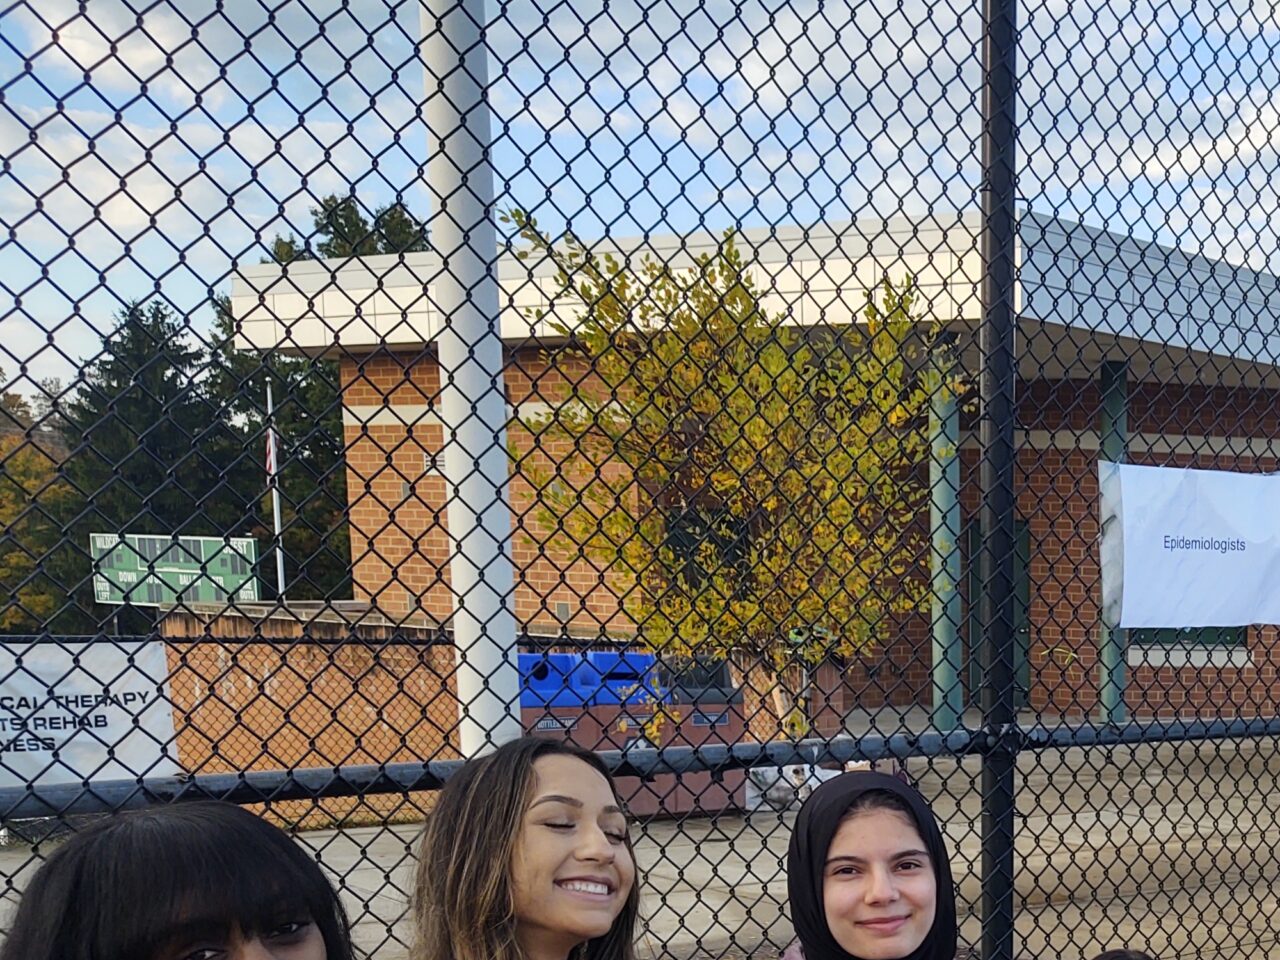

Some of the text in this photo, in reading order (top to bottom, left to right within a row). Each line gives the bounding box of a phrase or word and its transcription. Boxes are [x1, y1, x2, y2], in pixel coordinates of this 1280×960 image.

[1163, 535, 1246, 553] Epidemiologists
[119, 572, 137, 582] DOWN
[53, 691, 149, 709] THERAPY
[33, 715, 108, 730] REHAB
